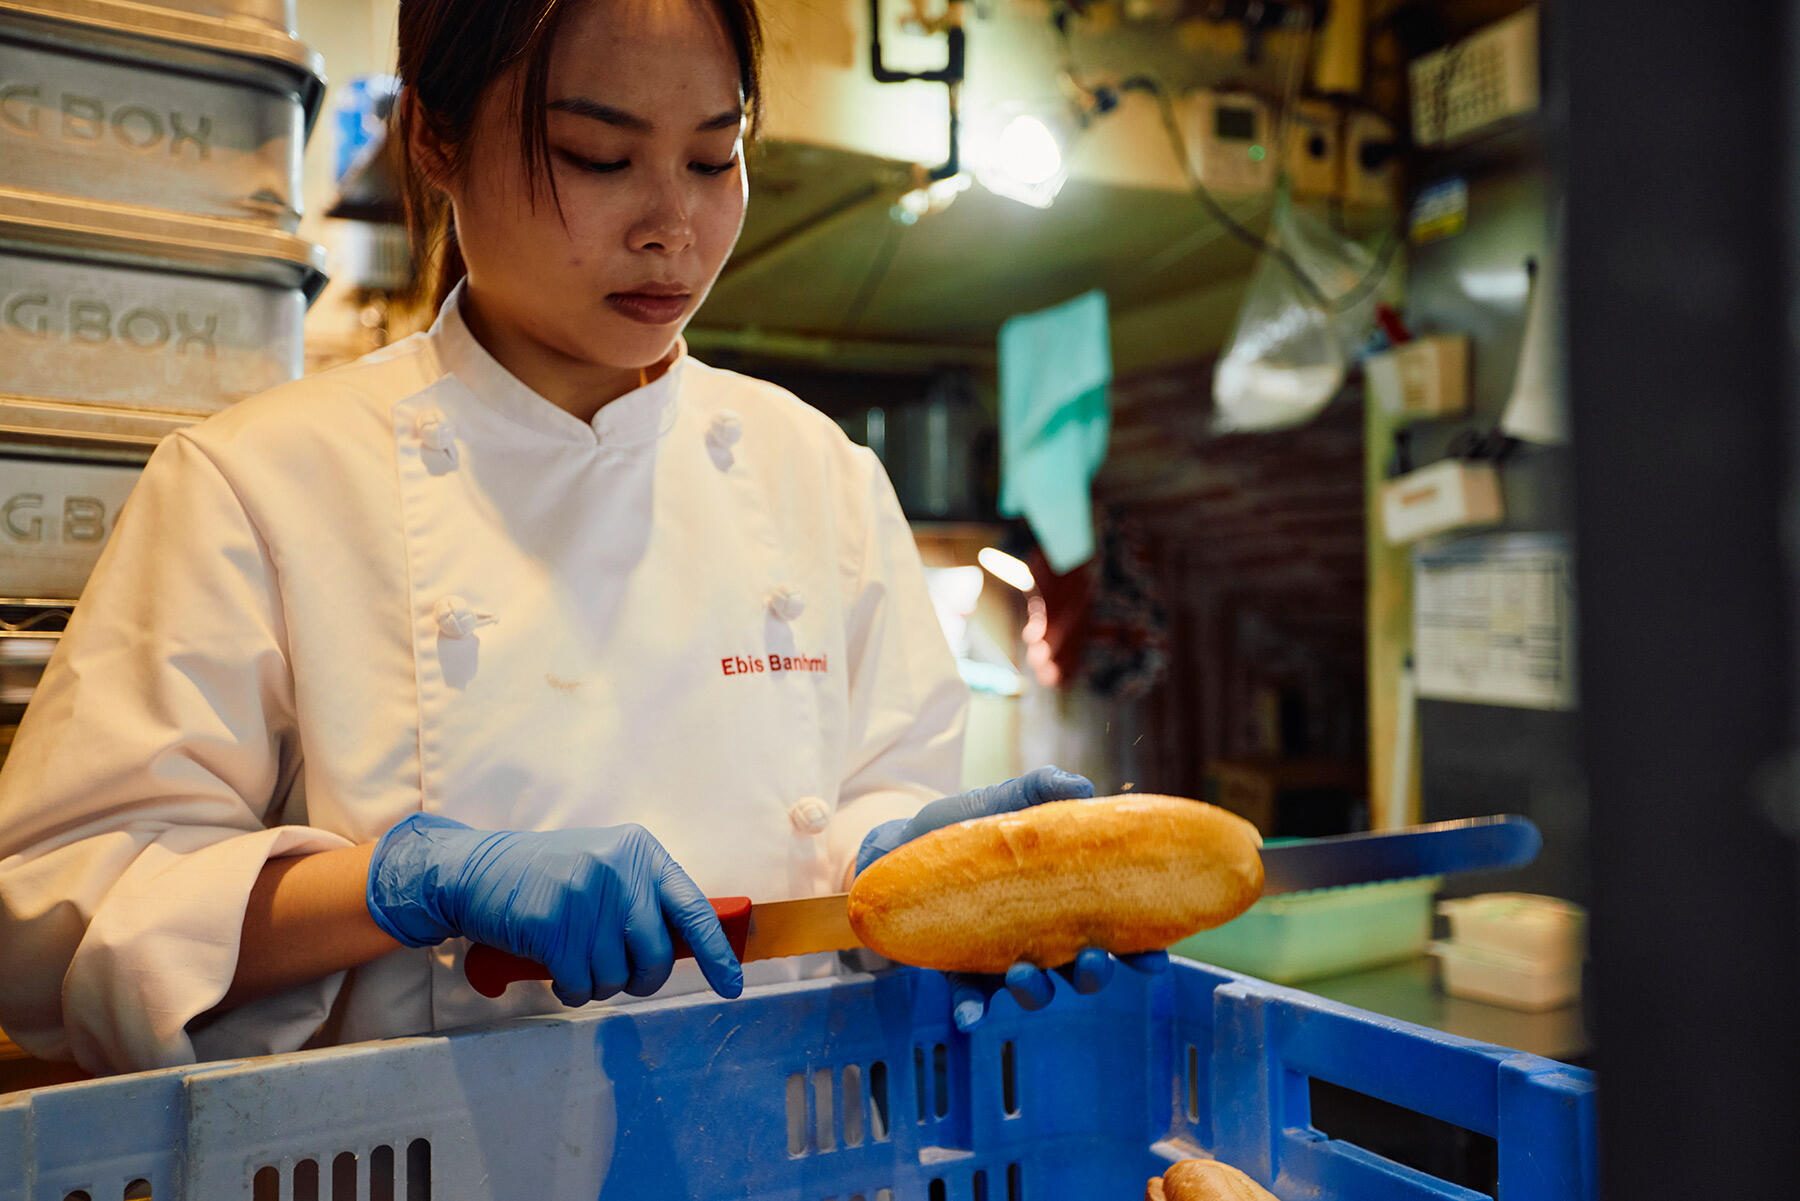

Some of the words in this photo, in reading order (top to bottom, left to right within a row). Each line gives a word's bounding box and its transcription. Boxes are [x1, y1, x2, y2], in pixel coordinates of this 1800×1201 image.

[61, 92, 212, 159] BOX
[68, 300, 218, 359] BOX
[721, 654, 765, 675] Ebis
